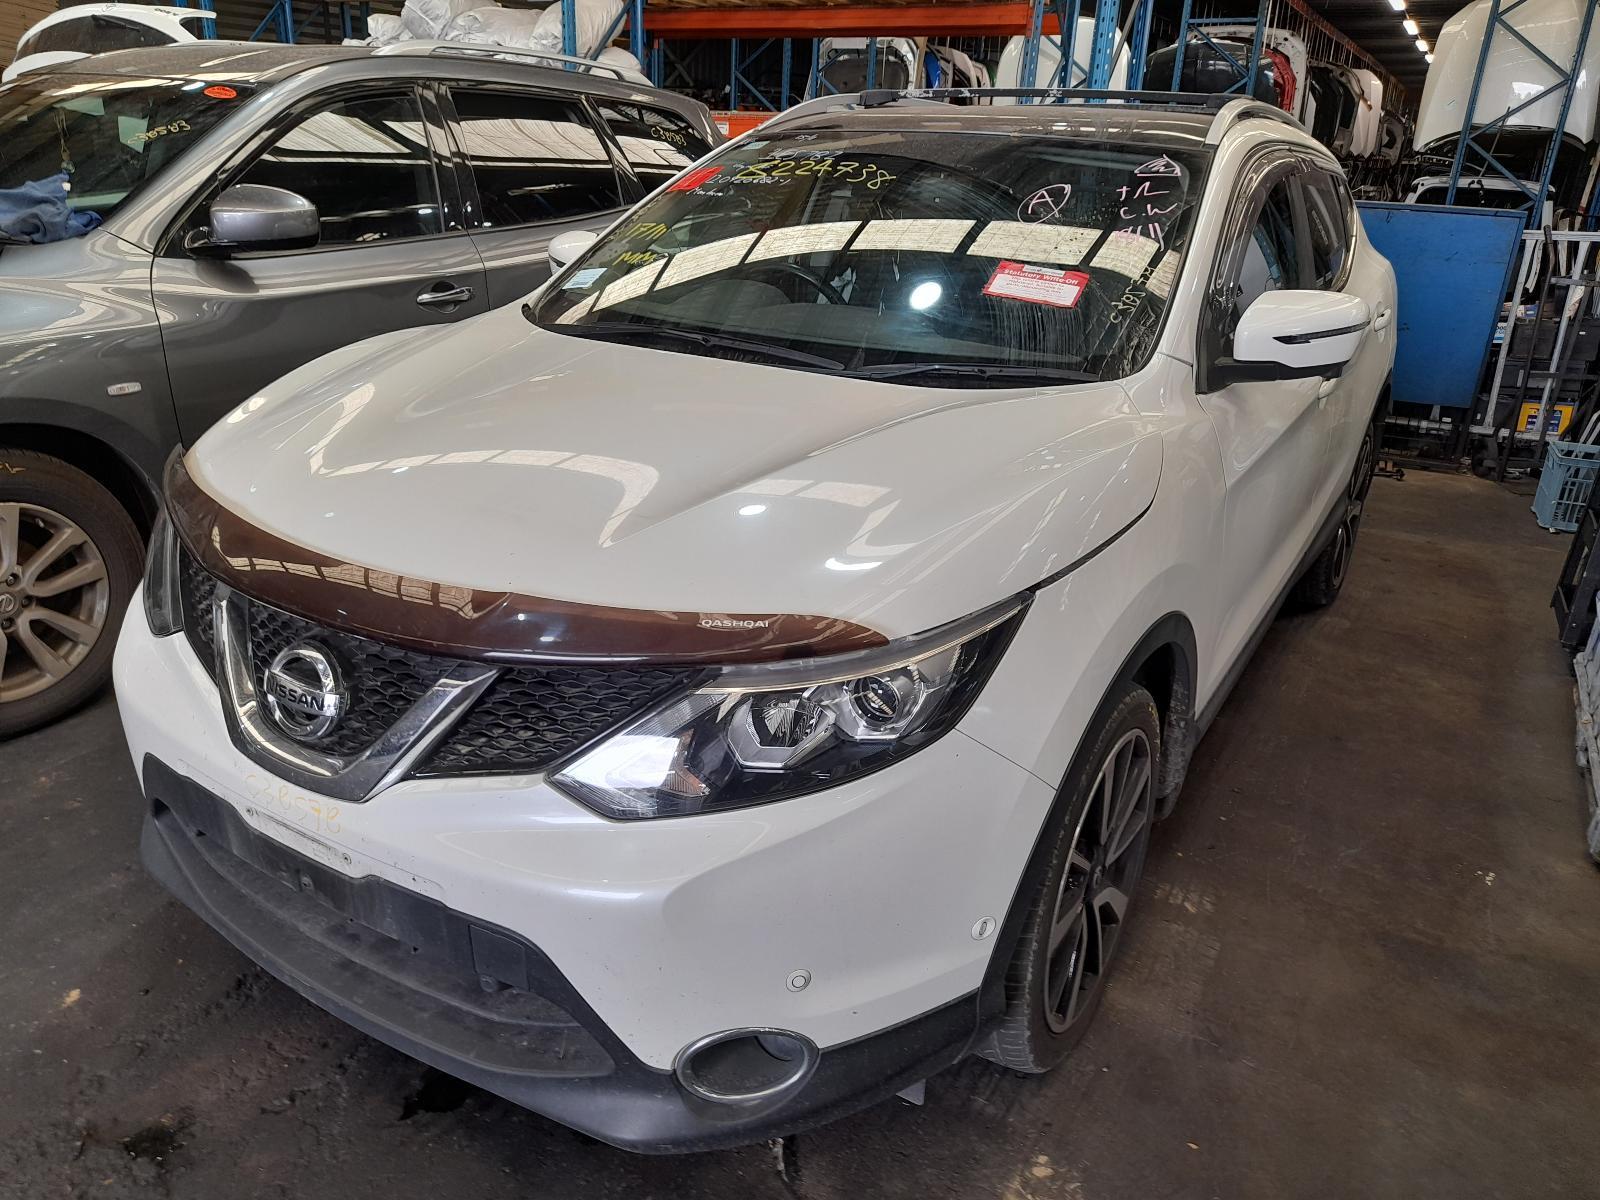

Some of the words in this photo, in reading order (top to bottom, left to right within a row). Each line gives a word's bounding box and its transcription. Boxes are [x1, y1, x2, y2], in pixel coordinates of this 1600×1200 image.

[1004, 268, 1041, 280] Statutory
[701, 619, 769, 629] QASHQAI
[267, 679, 326, 712] NISSAN
